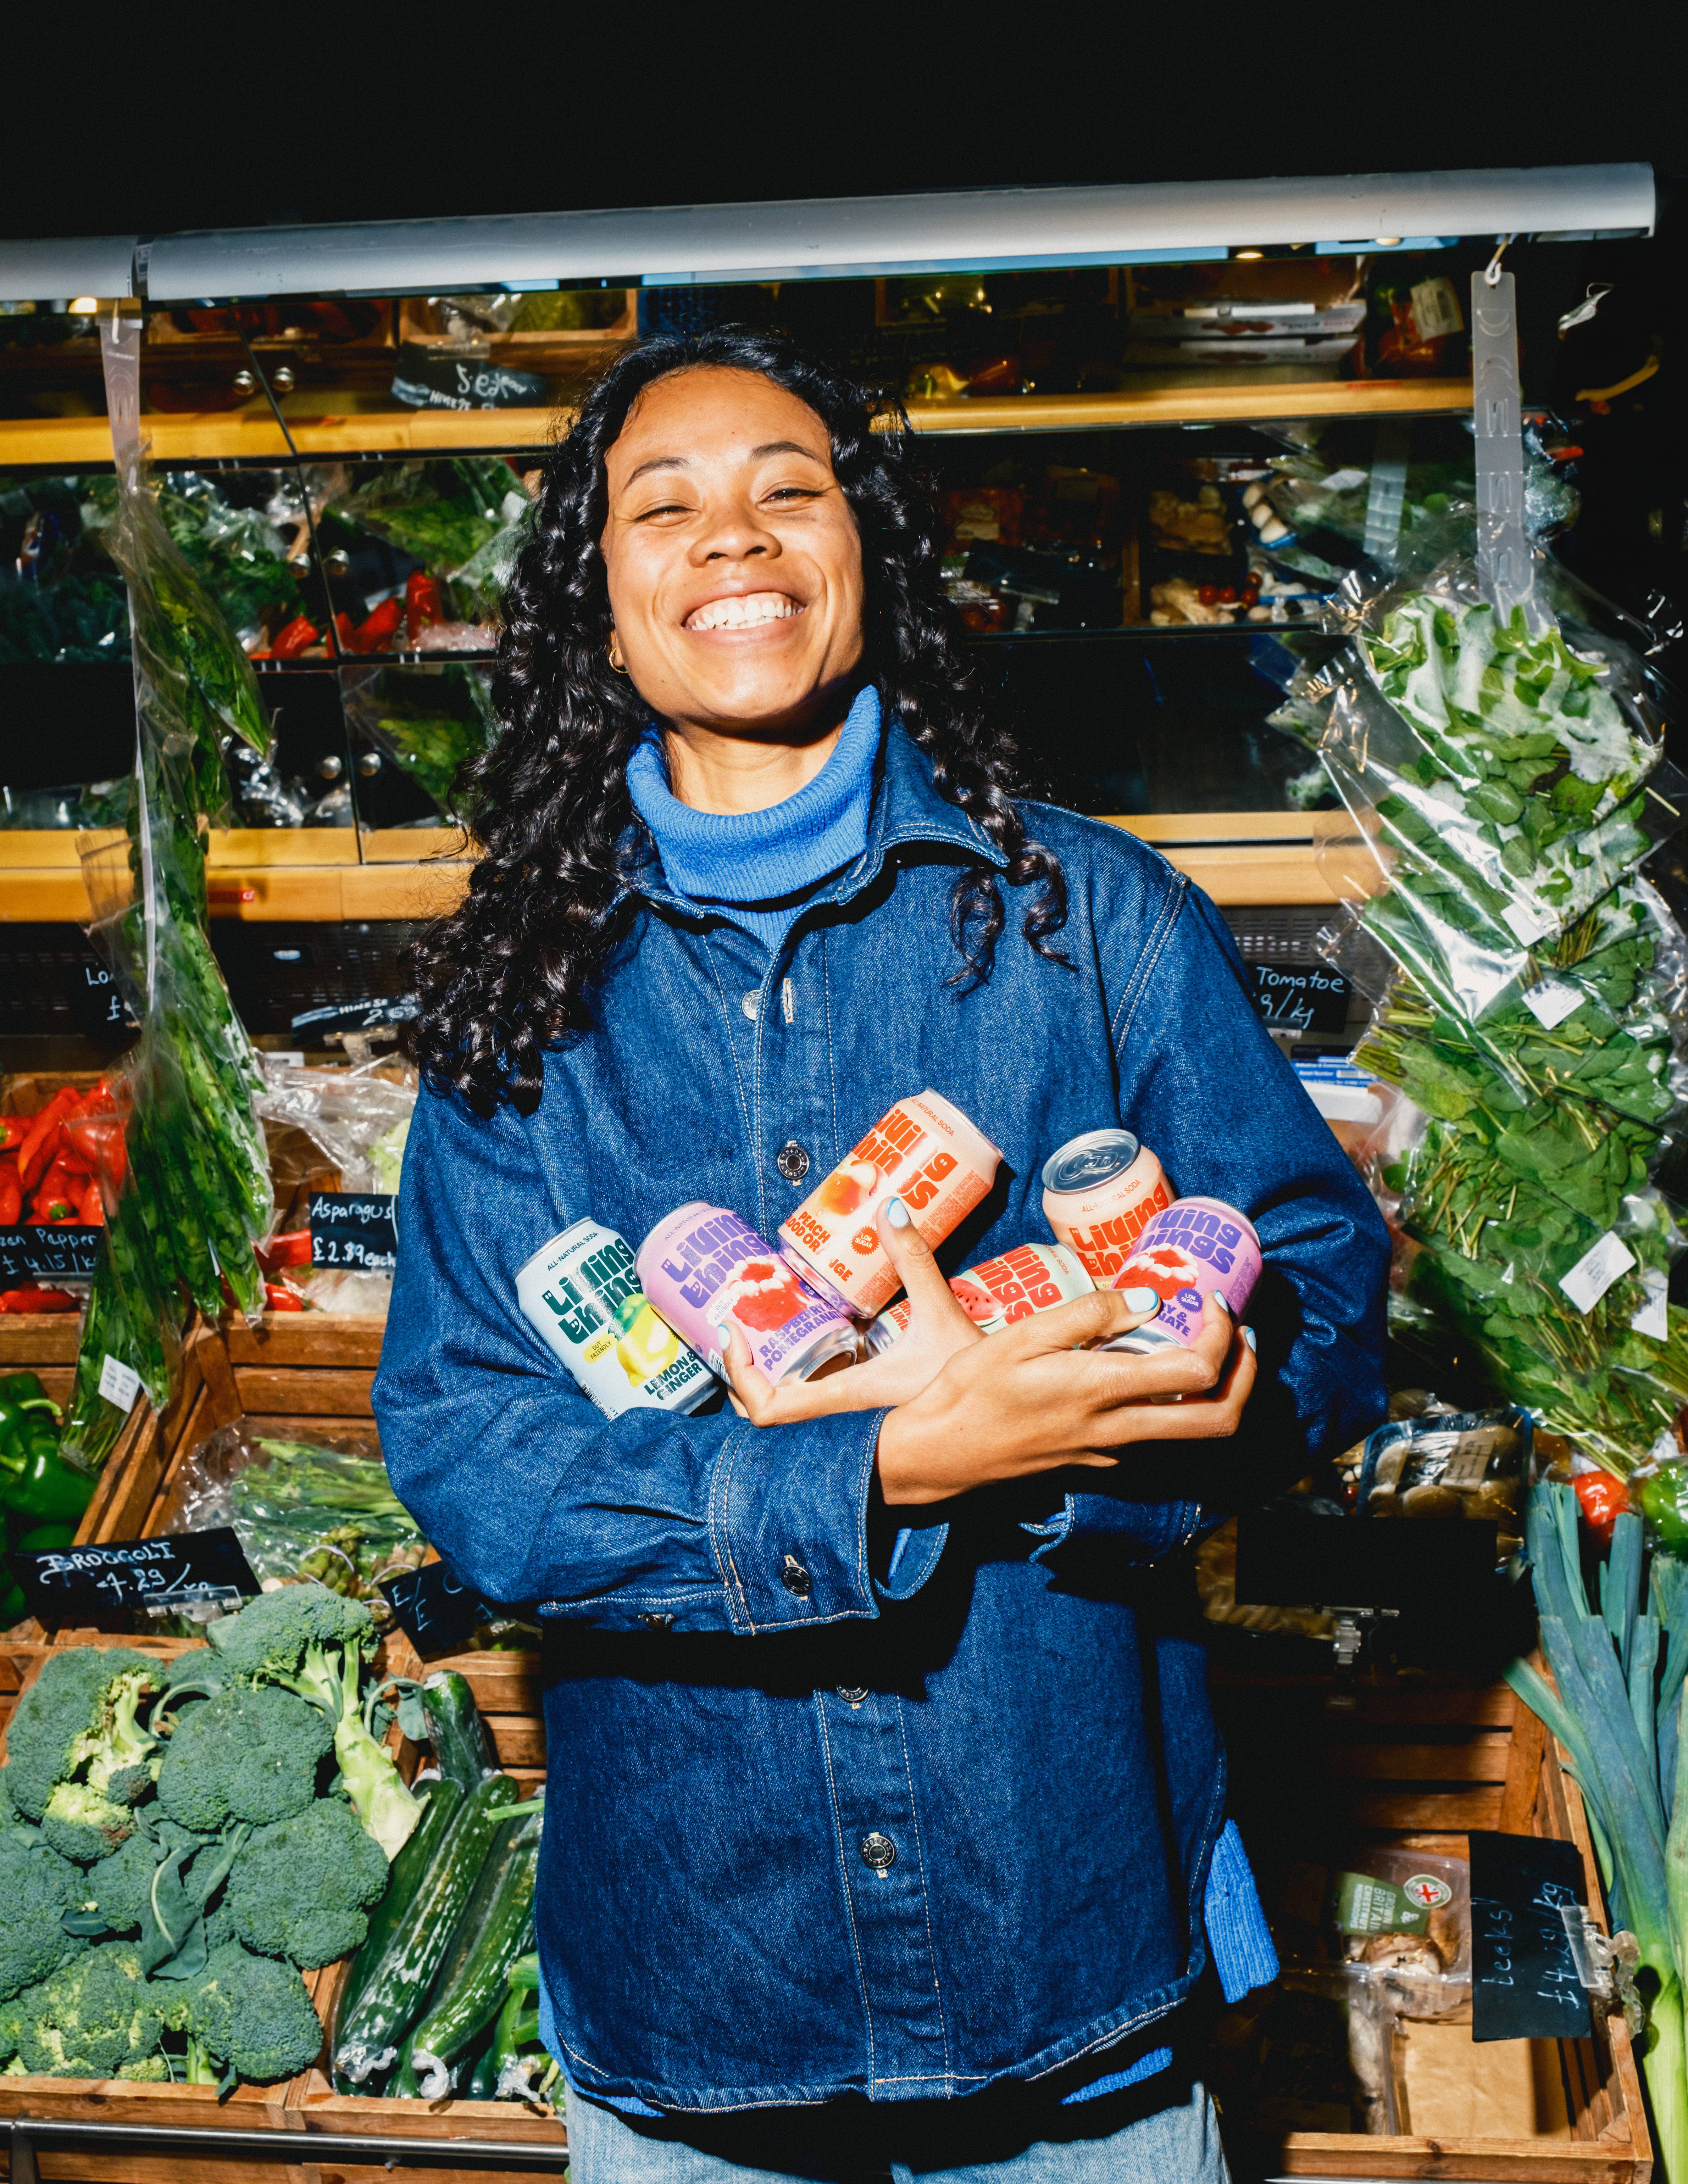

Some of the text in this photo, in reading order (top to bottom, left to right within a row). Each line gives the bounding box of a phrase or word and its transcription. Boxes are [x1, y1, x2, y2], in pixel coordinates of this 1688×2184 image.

[937, 1120, 955, 1137] SODA
[1124, 1179, 1141, 1194] SODA
[312, 1196, 392, 1224] Asparagus
[798, 1211, 831, 1244] PEACH
[35, 1227, 97, 1250] Pepper
[855, 1237, 873, 1249] SUGAR
[861, 1233, 873, 1242] LOW
[547, 1232, 599, 1271] ALL-NATURAL SODA
[1057, 1259, 1070, 1275] SODA
[557, 1266, 643, 1344] thing
[714, 1298, 734, 1321] FRIENDLY
[715, 1300, 724, 1310] GUT
[1181, 1297, 1199, 1307] SUGAR
[1176, 1311, 1187, 1323] &
[759, 1303, 826, 1359] RASPBERRY
[590, 1341, 612, 1360] FRIENDLY
[592, 1341, 602, 1351] GUT
[643, 1351, 698, 1395] LEMON &
[656, 1362, 703, 1401] GINGER
